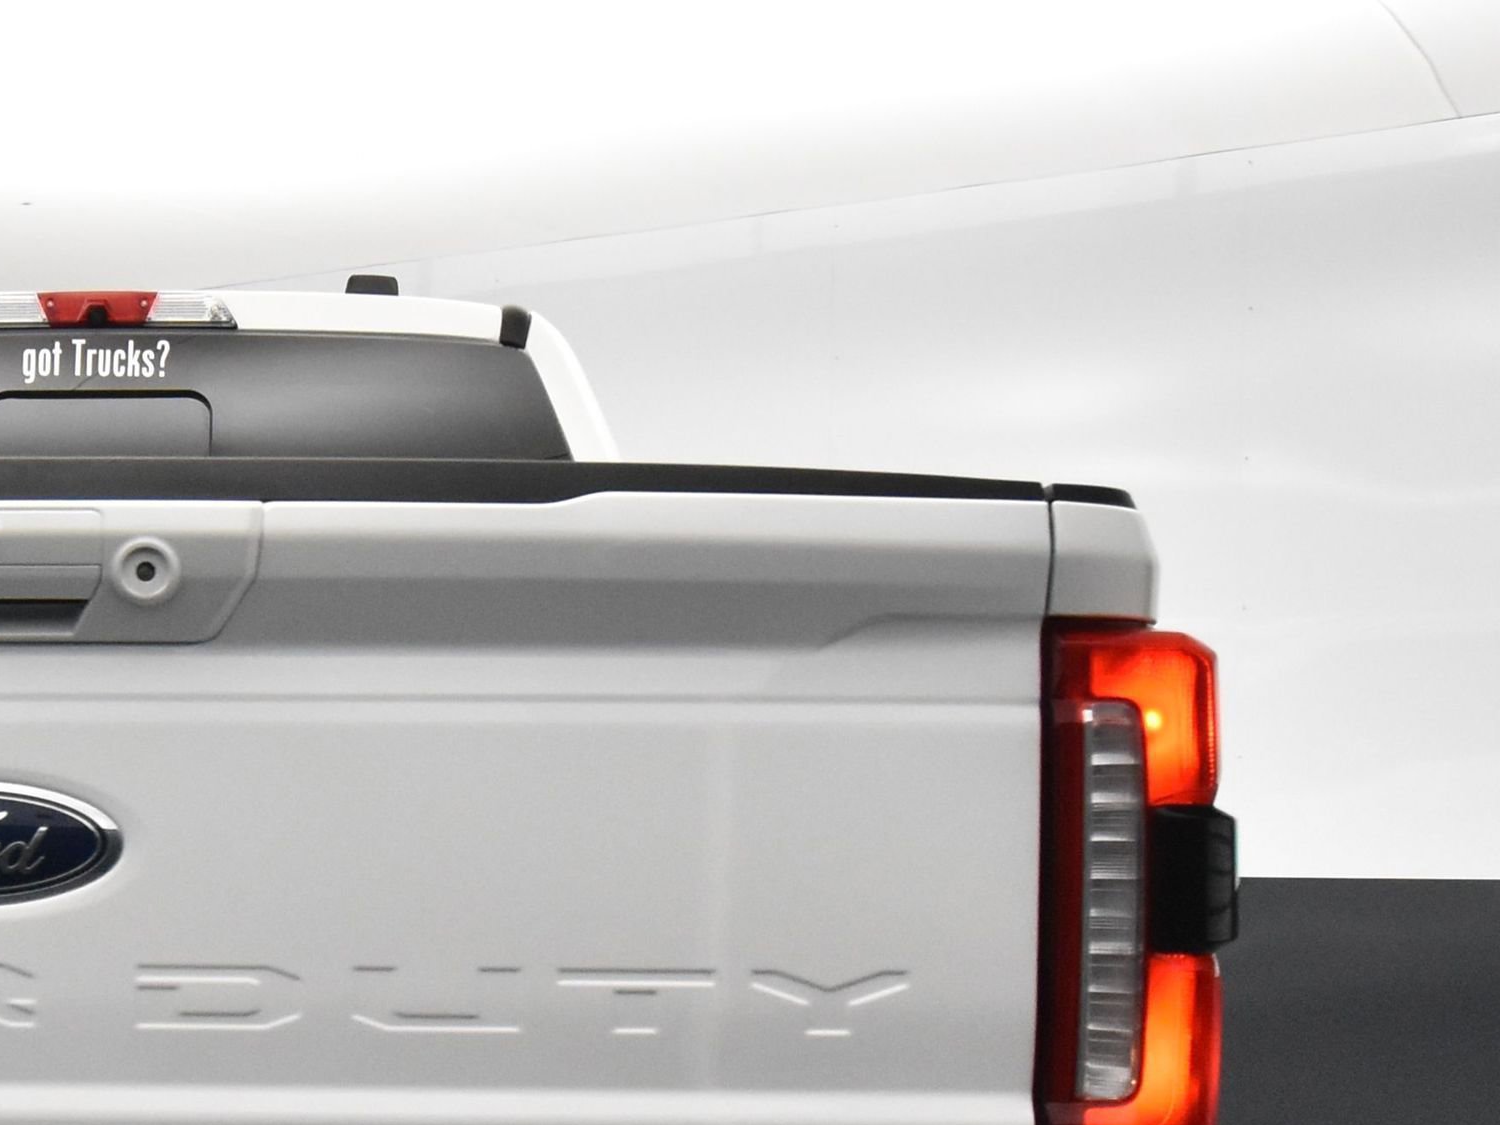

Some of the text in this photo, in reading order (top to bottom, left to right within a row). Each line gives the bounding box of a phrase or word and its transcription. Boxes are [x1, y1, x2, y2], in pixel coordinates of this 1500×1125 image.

[22, 338, 171, 384] got Trucks?
[134, 962, 910, 1037] DUTY
